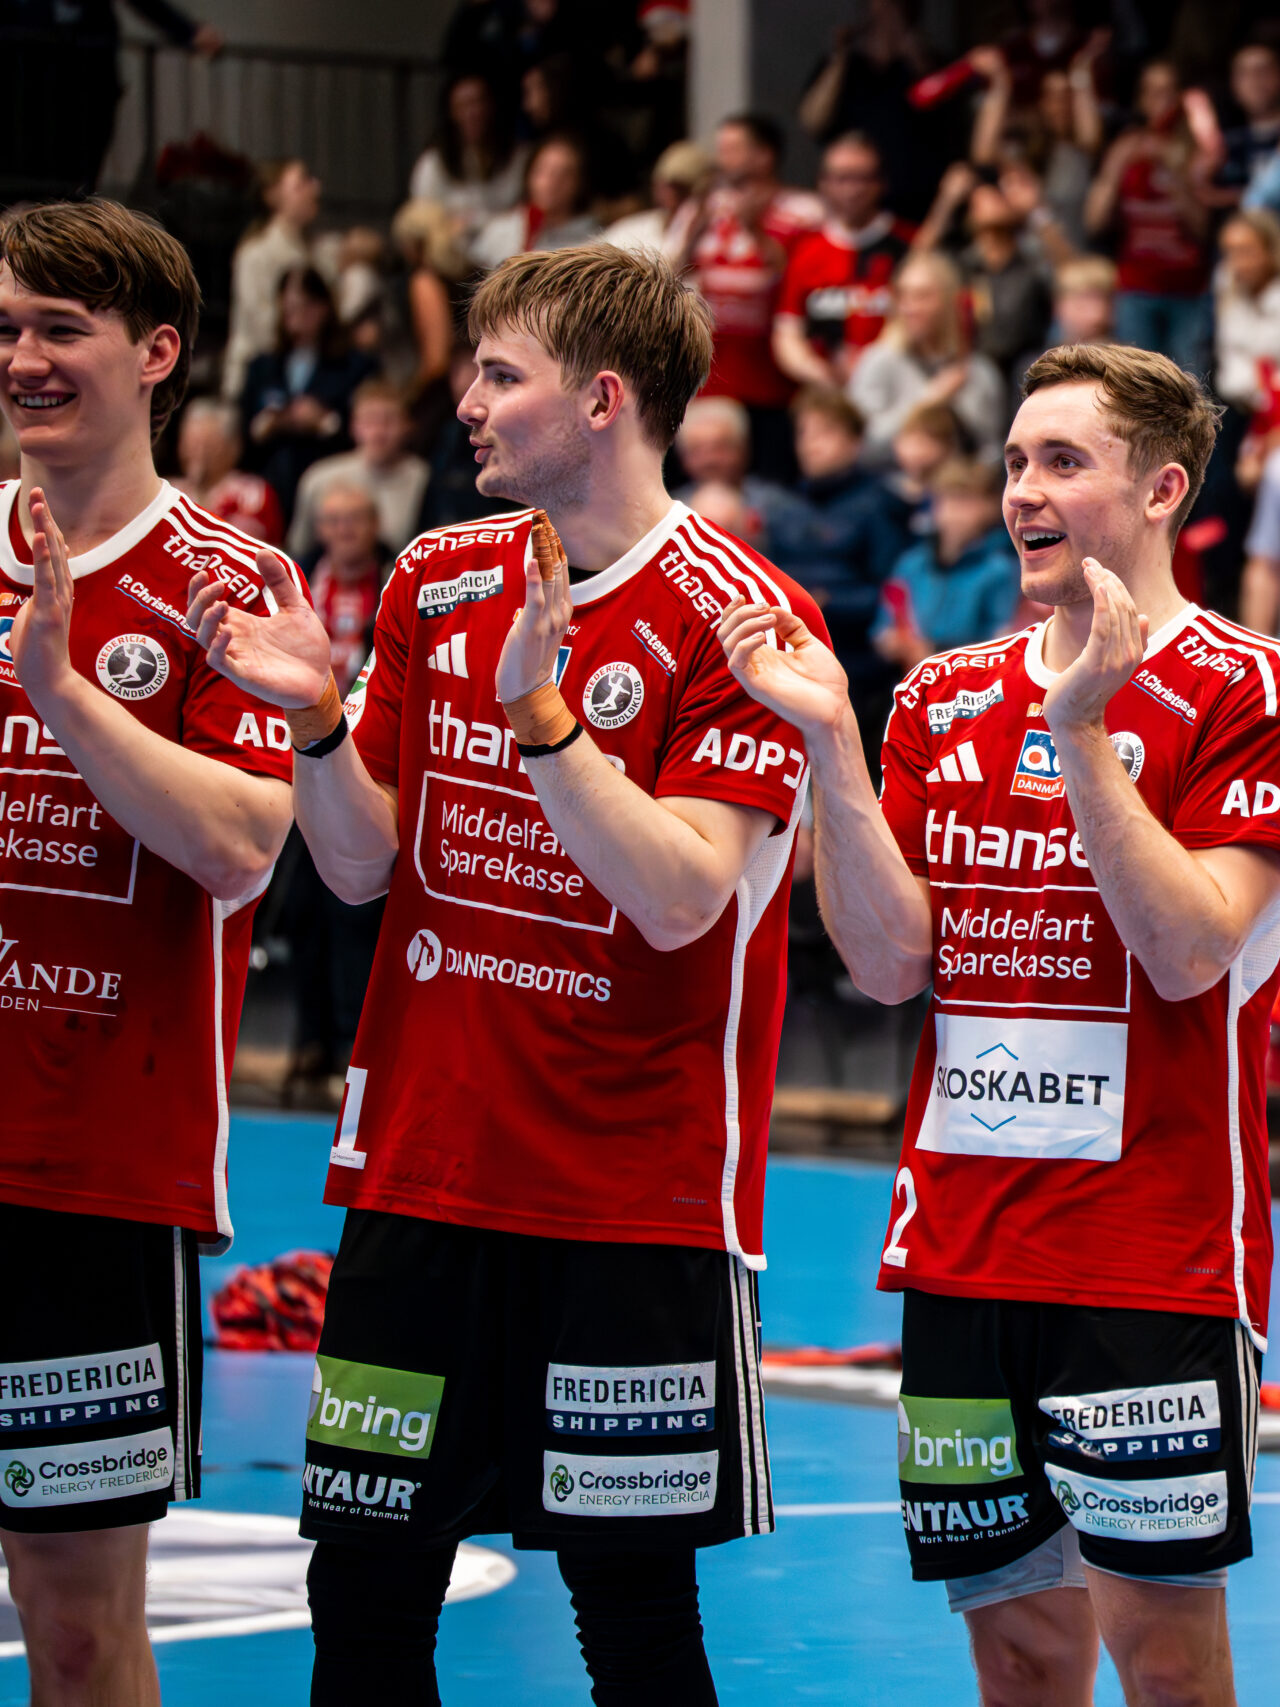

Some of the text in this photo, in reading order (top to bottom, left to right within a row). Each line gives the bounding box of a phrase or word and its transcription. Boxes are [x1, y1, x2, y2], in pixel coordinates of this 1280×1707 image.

[423, 574, 495, 602] FREDRICIA
[234, 712, 292, 751] AD
[441, 801, 567, 857] Middelfa
[925, 809, 1090, 871] thanse
[440, 839, 584, 896] Sparekasse
[941, 907, 1095, 943] Middelfart
[446, 947, 612, 1002] DANROBOTICS
[938, 944, 1092, 982] Sparekasse
[937, 1065, 1110, 1106] SKOSKABET
[882, 1166, 918, 1269] 2
[0, 1357, 156, 1400] FREDERICIA
[553, 1376, 706, 1404] FREDERICIA
[0, 1394, 160, 1427] SHIPPING
[319, 1387, 431, 1452] bring
[552, 1413, 707, 1431] SHIPPING
[39, 1447, 168, 1480] Crossbridge
[914, 1427, 1015, 1477] bring
[41, 1466, 170, 1496] ENERGY FREDERICIA
[579, 1469, 711, 1491] Crossbridge
[322, 1502, 346, 1513] Wear
[350, 1506, 361, 1515] of
[364, 1508, 410, 1522] Denmark
[579, 1490, 710, 1506] ENERGY FREDERICIA
[1083, 1492, 1218, 1515] Crossbridge
[918, 1535, 943, 1545] Work
[946, 1534, 970, 1543] Wear
[973, 1531, 984, 1540] of
[1085, 1512, 1220, 1530] ENERGY FREDERICIA
